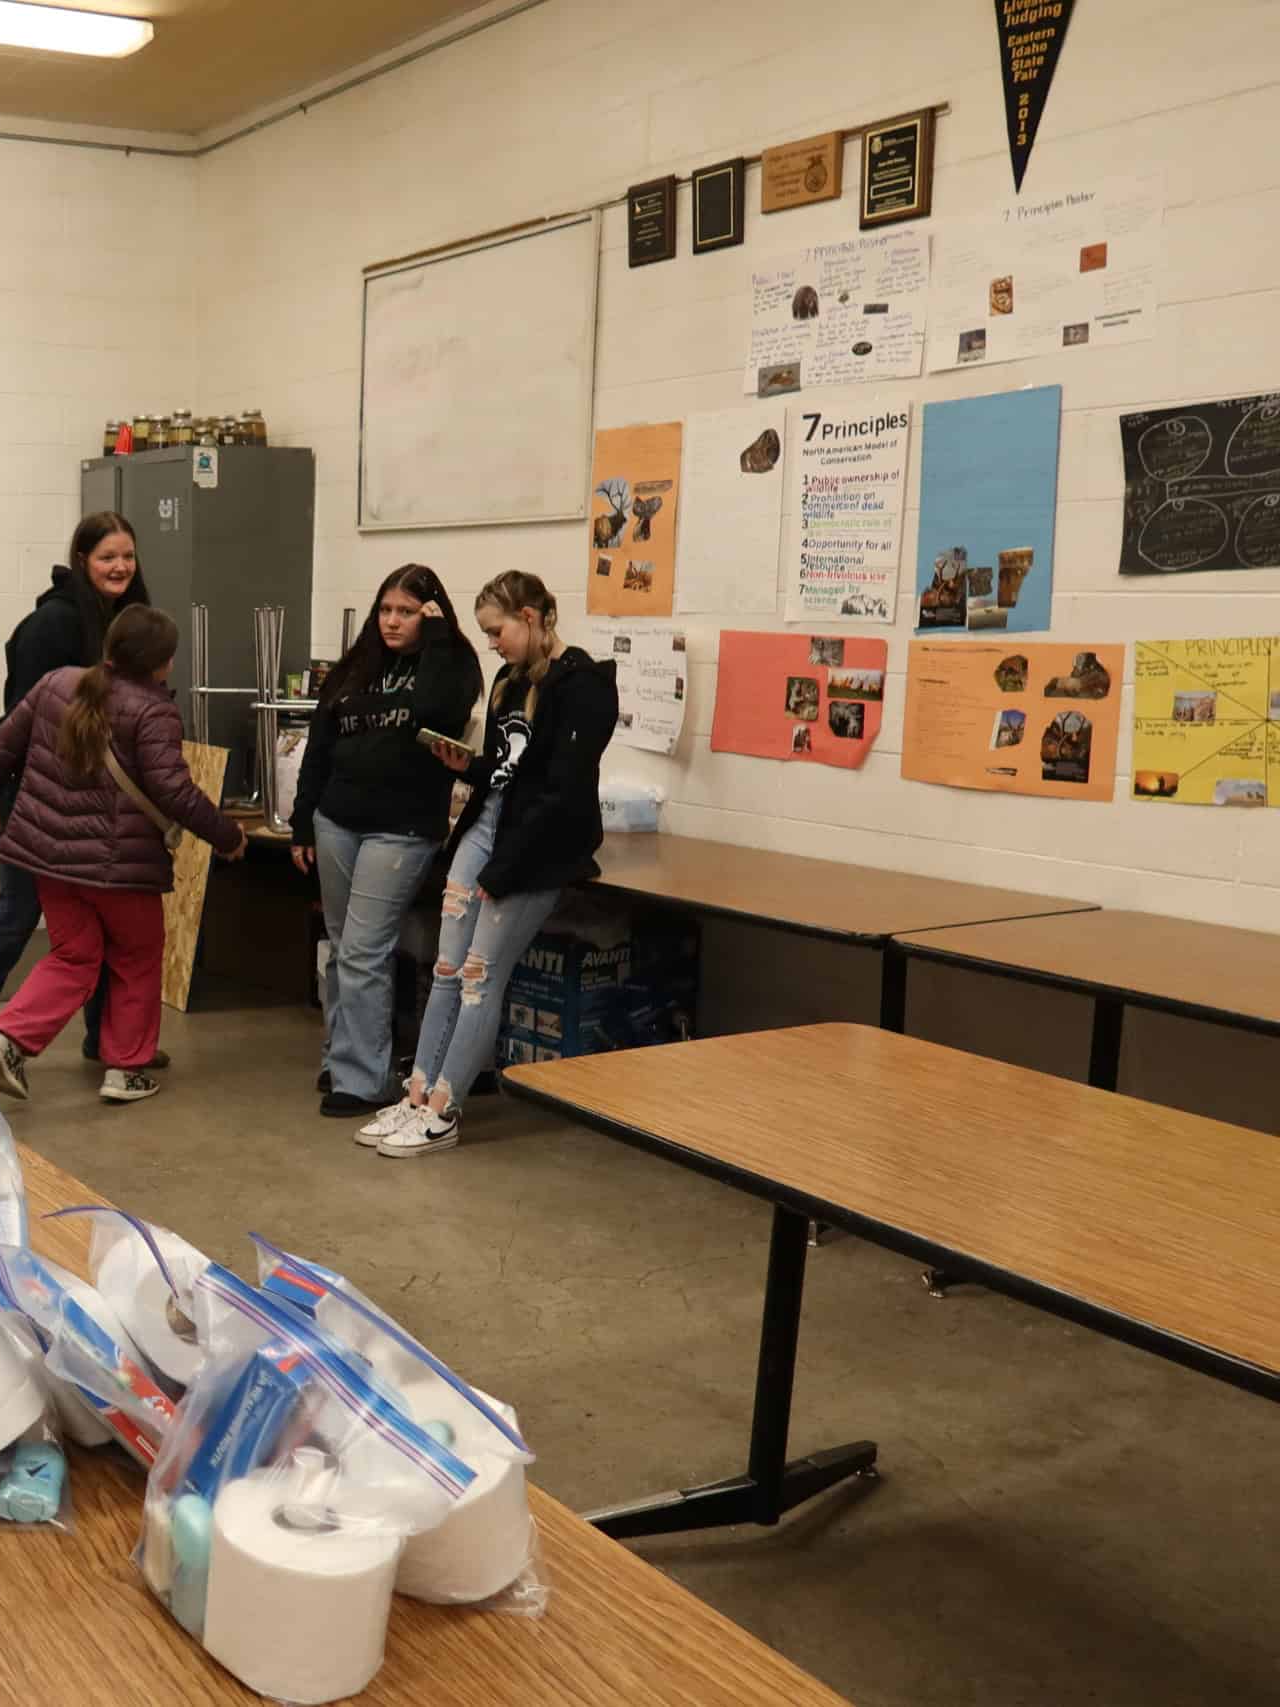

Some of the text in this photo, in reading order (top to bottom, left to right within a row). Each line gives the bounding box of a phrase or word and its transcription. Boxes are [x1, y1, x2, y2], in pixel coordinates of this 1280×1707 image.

[1005, 3, 1062, 27] Judging
[1007, 27, 1056, 48] Eastern
[1011, 42, 1048, 59] Idaho
[1011, 56, 1044, 72] State
[1013, 69, 1039, 83] Fair
[802, 411, 908, 442] 7 Principles
[802, 447, 825, 457] North
[826, 444, 863, 455] American
[864, 440, 889, 451] Model
[820, 453, 872, 465] Conservation
[811, 475, 840, 486] Public
[841, 470, 889, 485] ownership
[891, 469, 900, 479] of
[810, 493, 861, 503] Prohibition
[861, 501, 885, 510] dead
[801, 520, 809, 529] 3
[801, 538, 892, 551] 4 Opportunity for all
[800, 552, 864, 564] 5 International
[799, 569, 807, 579] 6
[799, 583, 806, 595] 7
[805, 584, 845, 594] Managed
[581, 948, 632, 968] AVANTI
